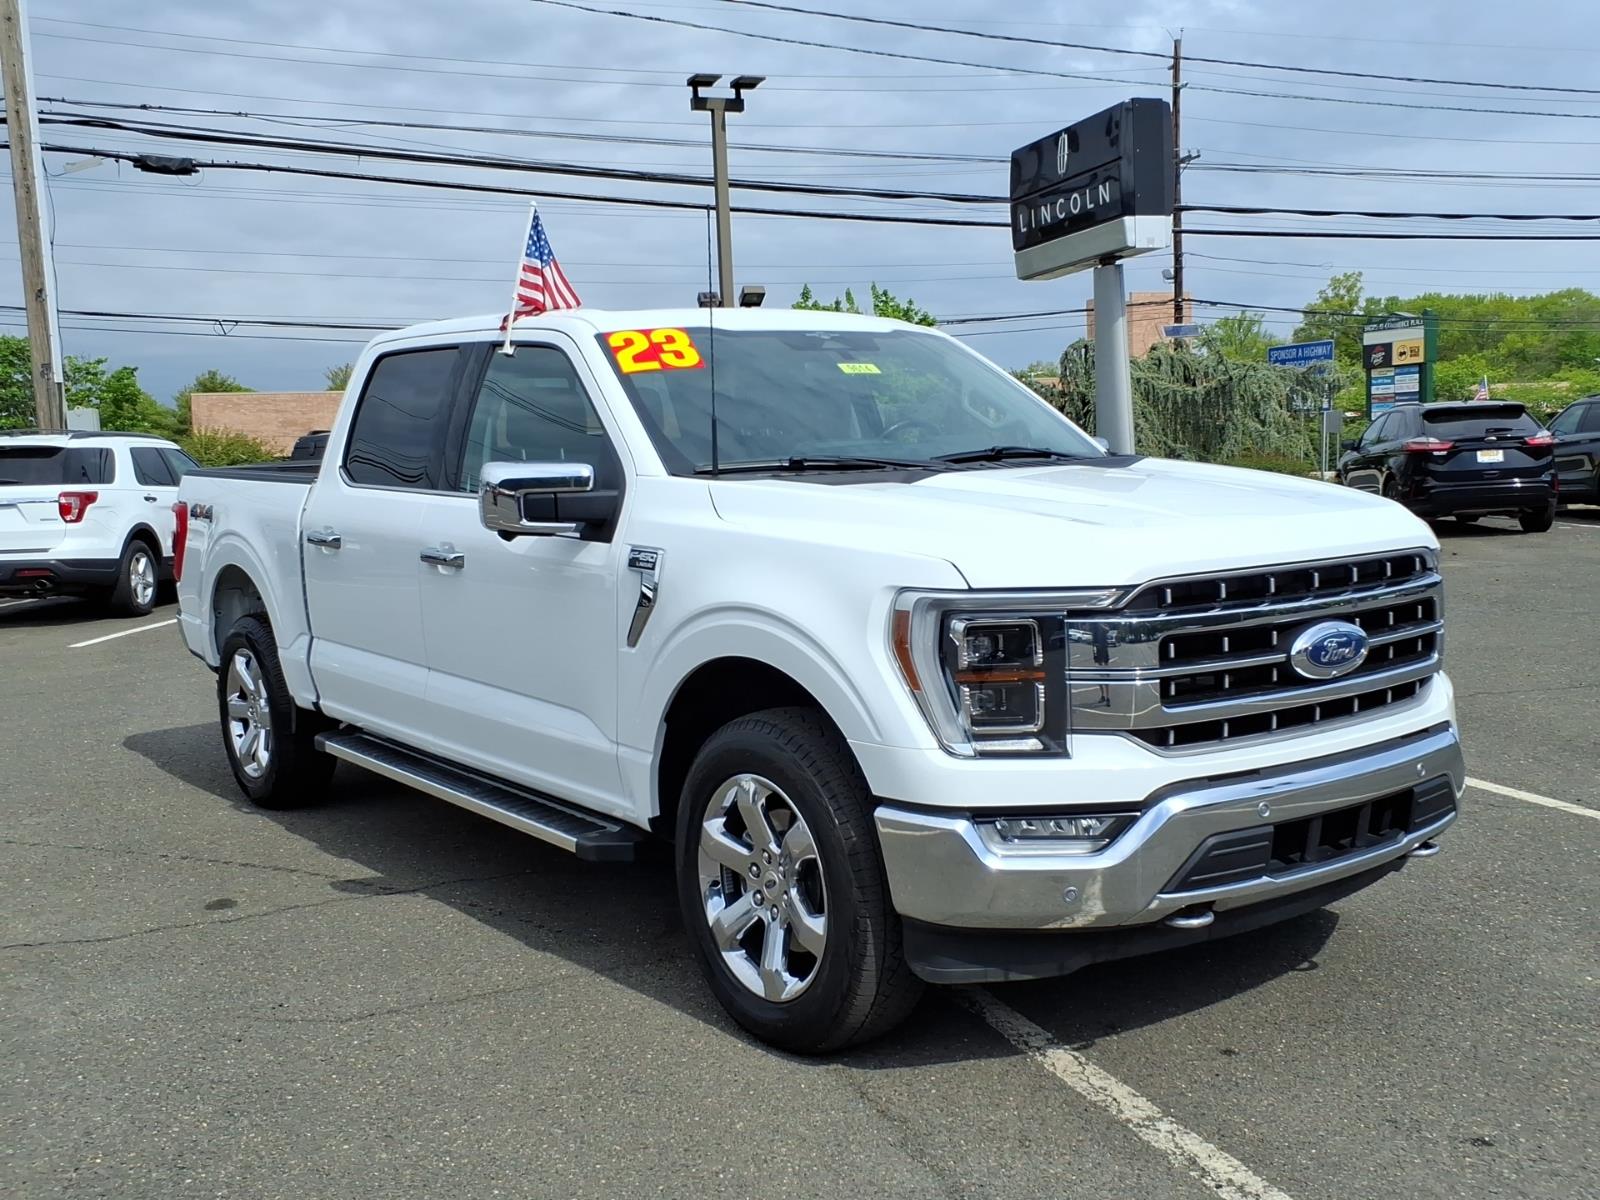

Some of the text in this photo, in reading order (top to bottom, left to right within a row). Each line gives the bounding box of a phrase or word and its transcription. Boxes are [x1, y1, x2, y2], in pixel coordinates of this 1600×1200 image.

[1019, 181, 1111, 233] LINCOLN
[608, 328, 700, 374] 23
[1270, 344, 1332, 361] SPONSOR A HIGHWAY
[1320, 637, 1356, 663] Ford
